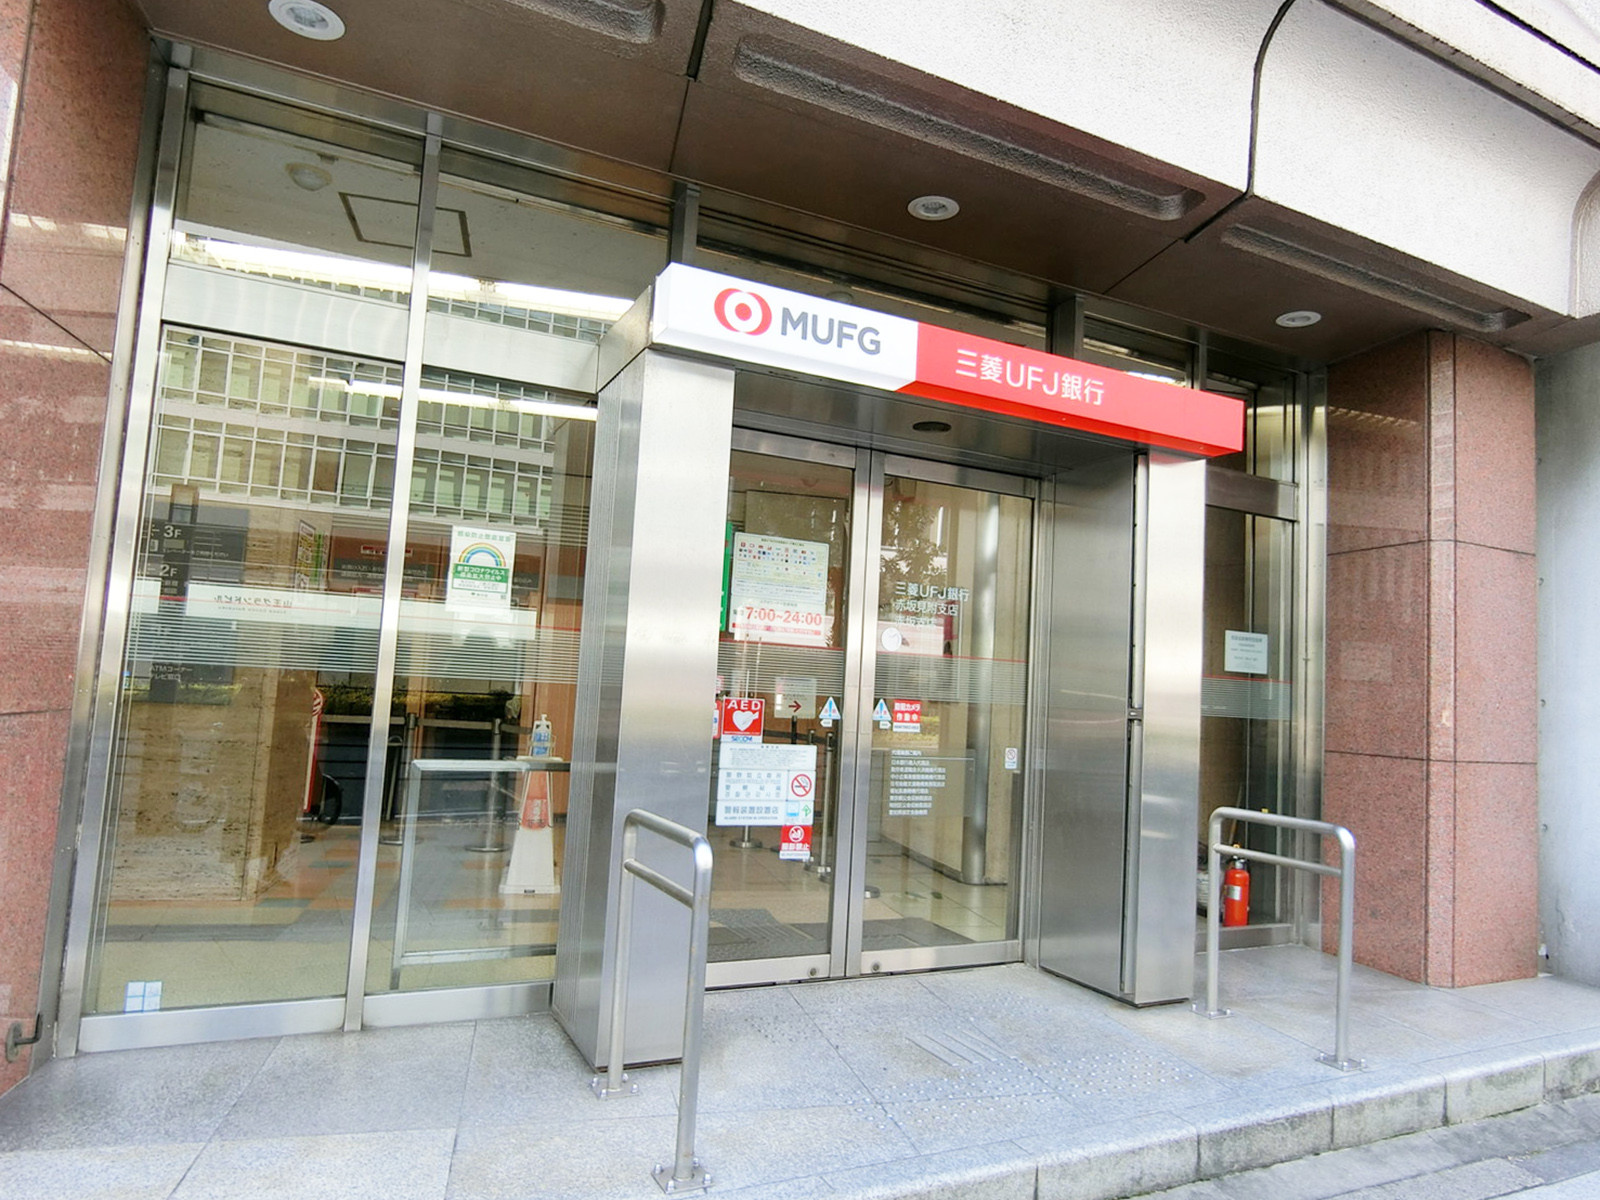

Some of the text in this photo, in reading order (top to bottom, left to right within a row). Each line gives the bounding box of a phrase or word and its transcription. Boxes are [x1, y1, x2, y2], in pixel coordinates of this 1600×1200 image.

[781, 307, 881, 355] MUFG
[955, 348, 1105, 406] 三菱UFJ銀行
[163, 525, 182, 539] 3F
[160, 563, 178, 577] 2F
[894, 581, 970, 602] 三菱UFJ銀行
[727, 699, 761, 711] AED
